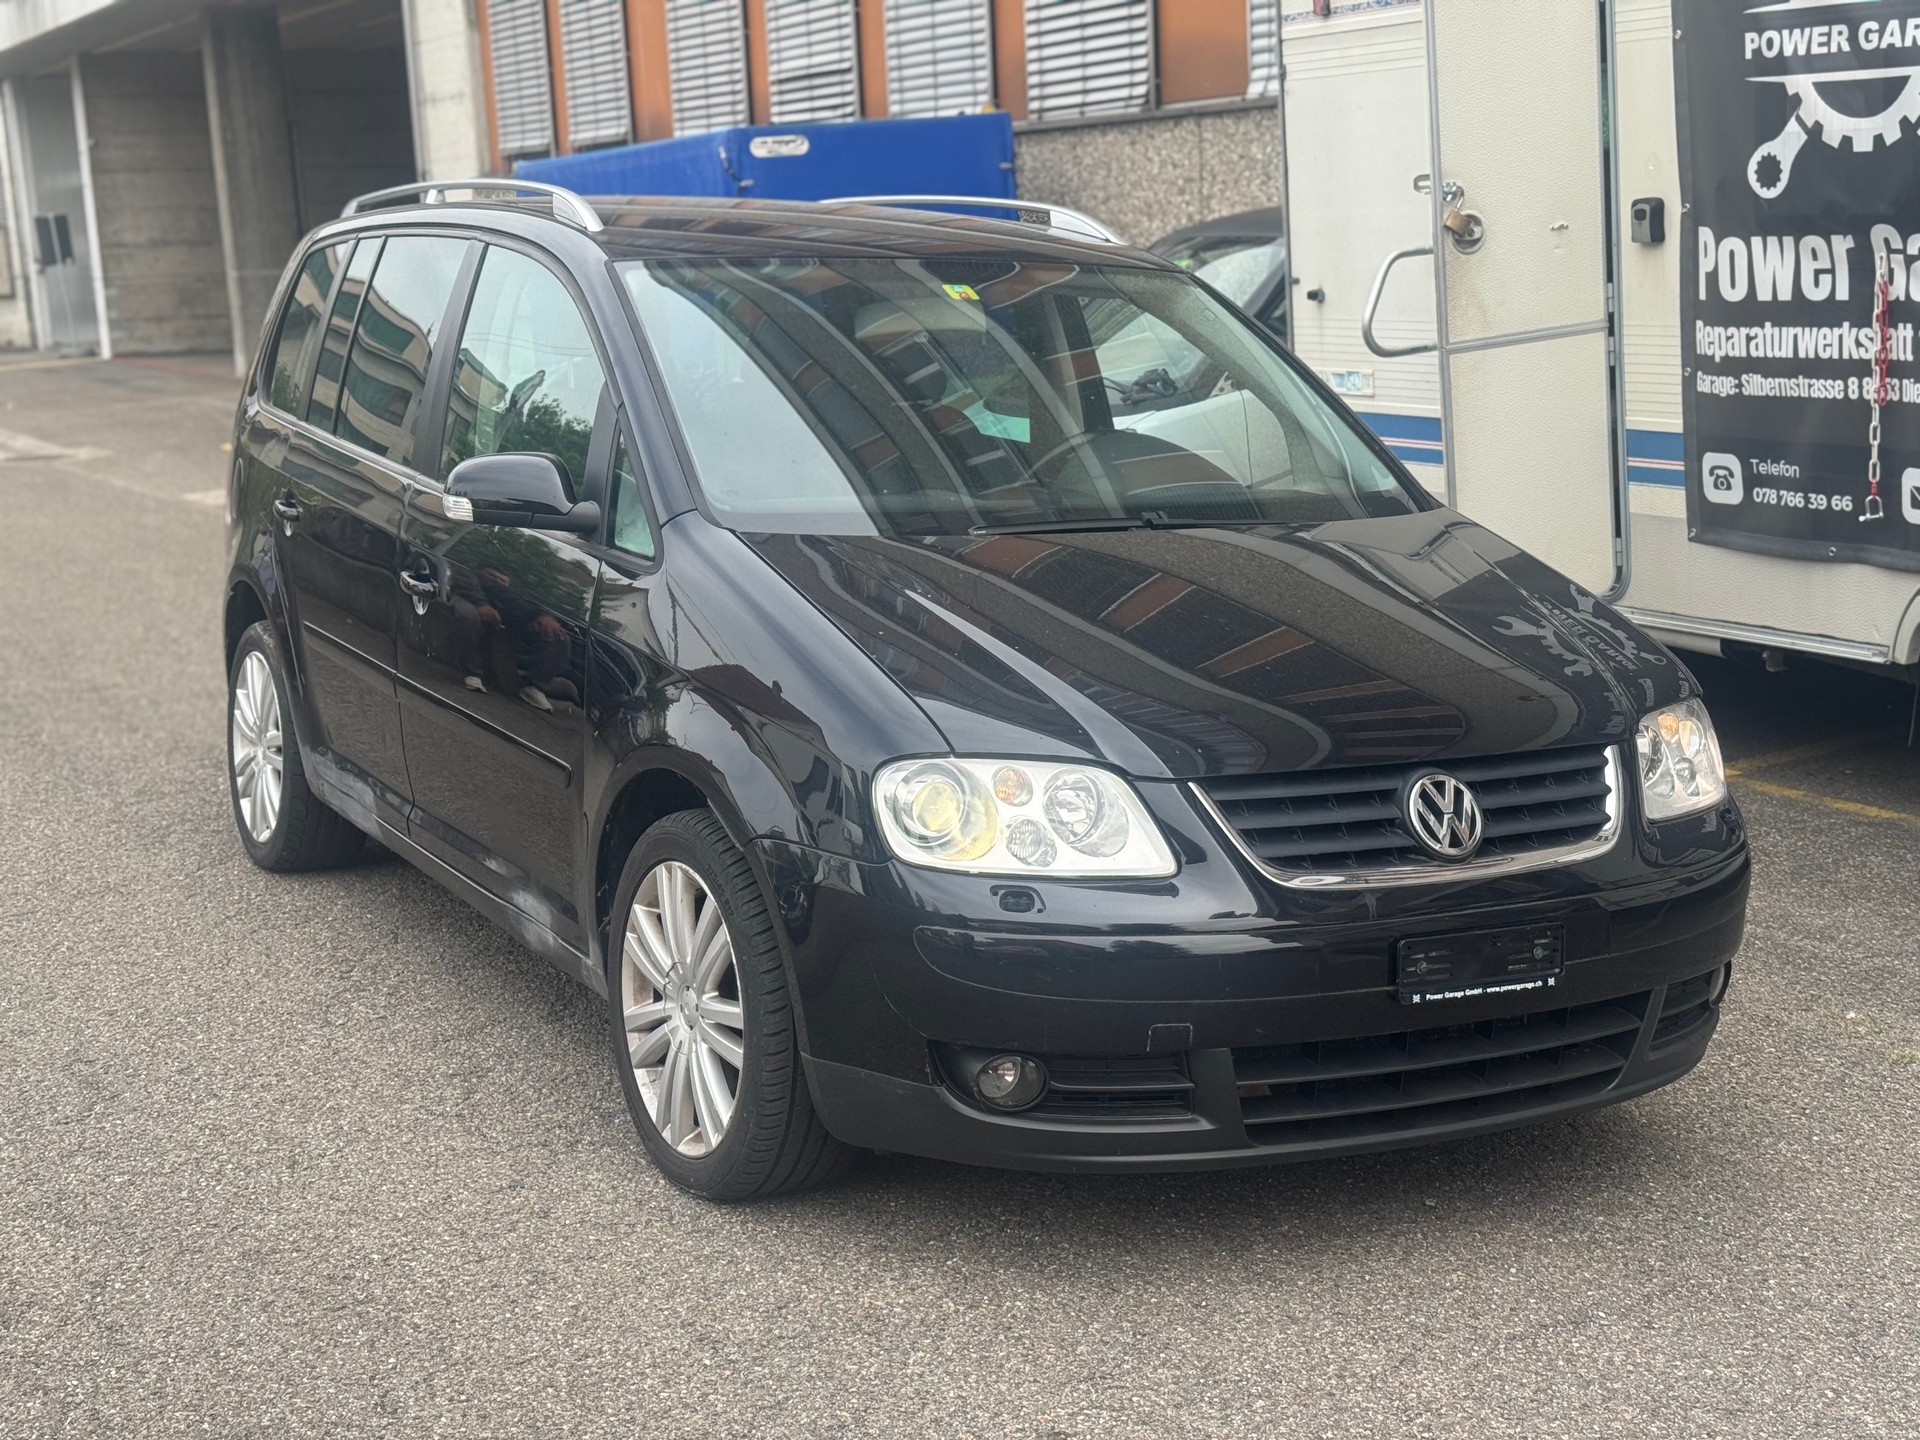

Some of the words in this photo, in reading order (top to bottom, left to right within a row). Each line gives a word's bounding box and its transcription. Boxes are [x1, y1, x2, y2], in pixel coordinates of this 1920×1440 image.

[1745, 24, 1851, 60] POWER
[1858, 17, 1920, 51] GAR
[1698, 226, 1855, 302] Power
[1696, 320, 1914, 362] Reparaturwerksatt
[1696, 371, 1739, 396] Garage:
[1741, 373, 1844, 399] Silbernstrasse
[1848, 377, 1859, 400] 8
[1750, 458, 1800, 478] Telefon
[1753, 487, 1778, 505] 078
[1779, 490, 1805, 508] 766
[1808, 493, 1827, 510] 39
[1831, 495, 1853, 511] 66
[1426, 992, 1444, 1001] Power
[1444, 990, 1465, 999] Garage
[1465, 987, 1483, 996] GmbH
[1486, 980, 1543, 994] www.powergarage.ch
